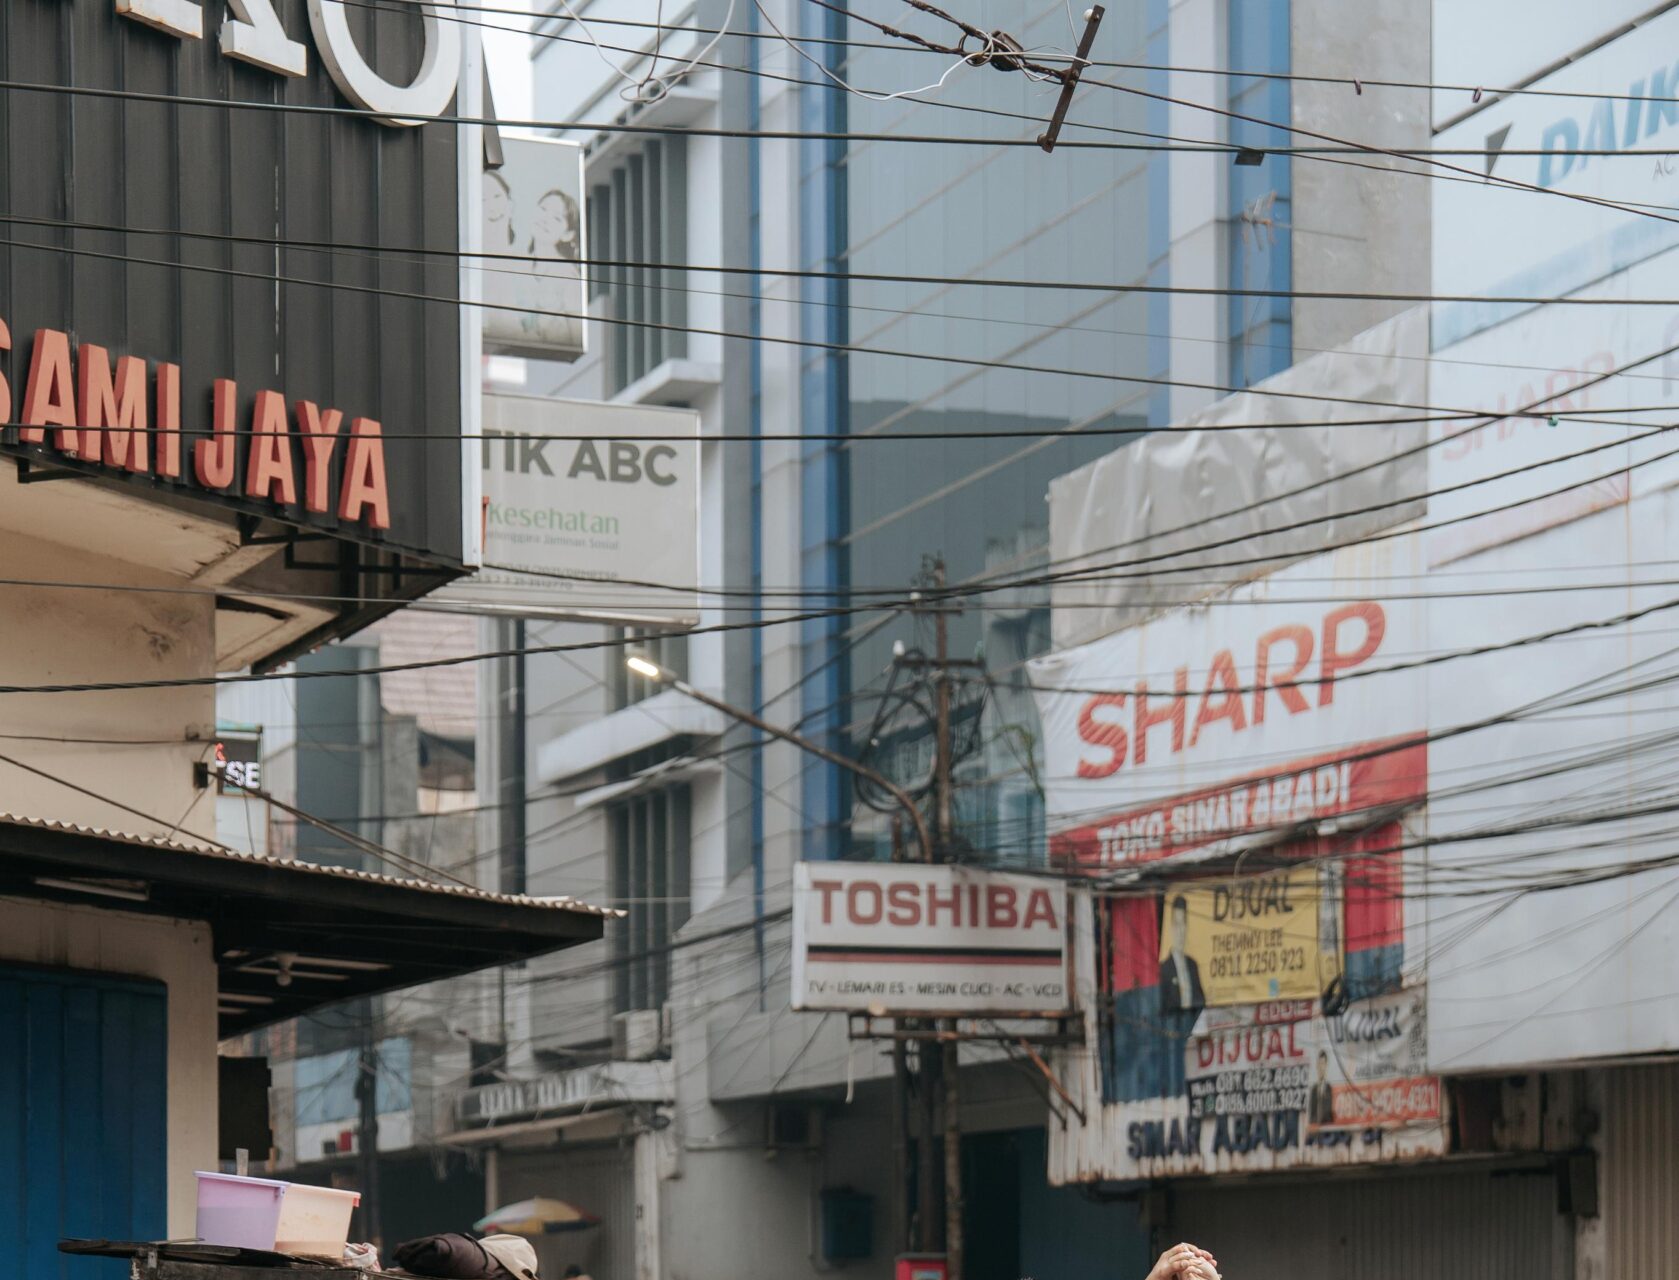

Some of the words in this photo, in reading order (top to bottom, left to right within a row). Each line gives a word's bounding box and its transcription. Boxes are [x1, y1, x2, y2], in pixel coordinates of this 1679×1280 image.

[1441, 351, 1615, 462] SHARP
[195, 378, 390, 529] JAYA
[567, 437, 677, 486] ABC
[1076, 600, 1386, 779] SHARP
[1255, 761, 1350, 827] ABADI
[811, 880, 1058, 930] TOSHIBA
[917, 983, 956, 996] MESIN
[960, 983, 993, 997] CUCI
[1003, 984, 1024, 998] AC
[1033, 984, 1062, 998] VCD
[1197, 1023, 1304, 1068] DIJUAL
